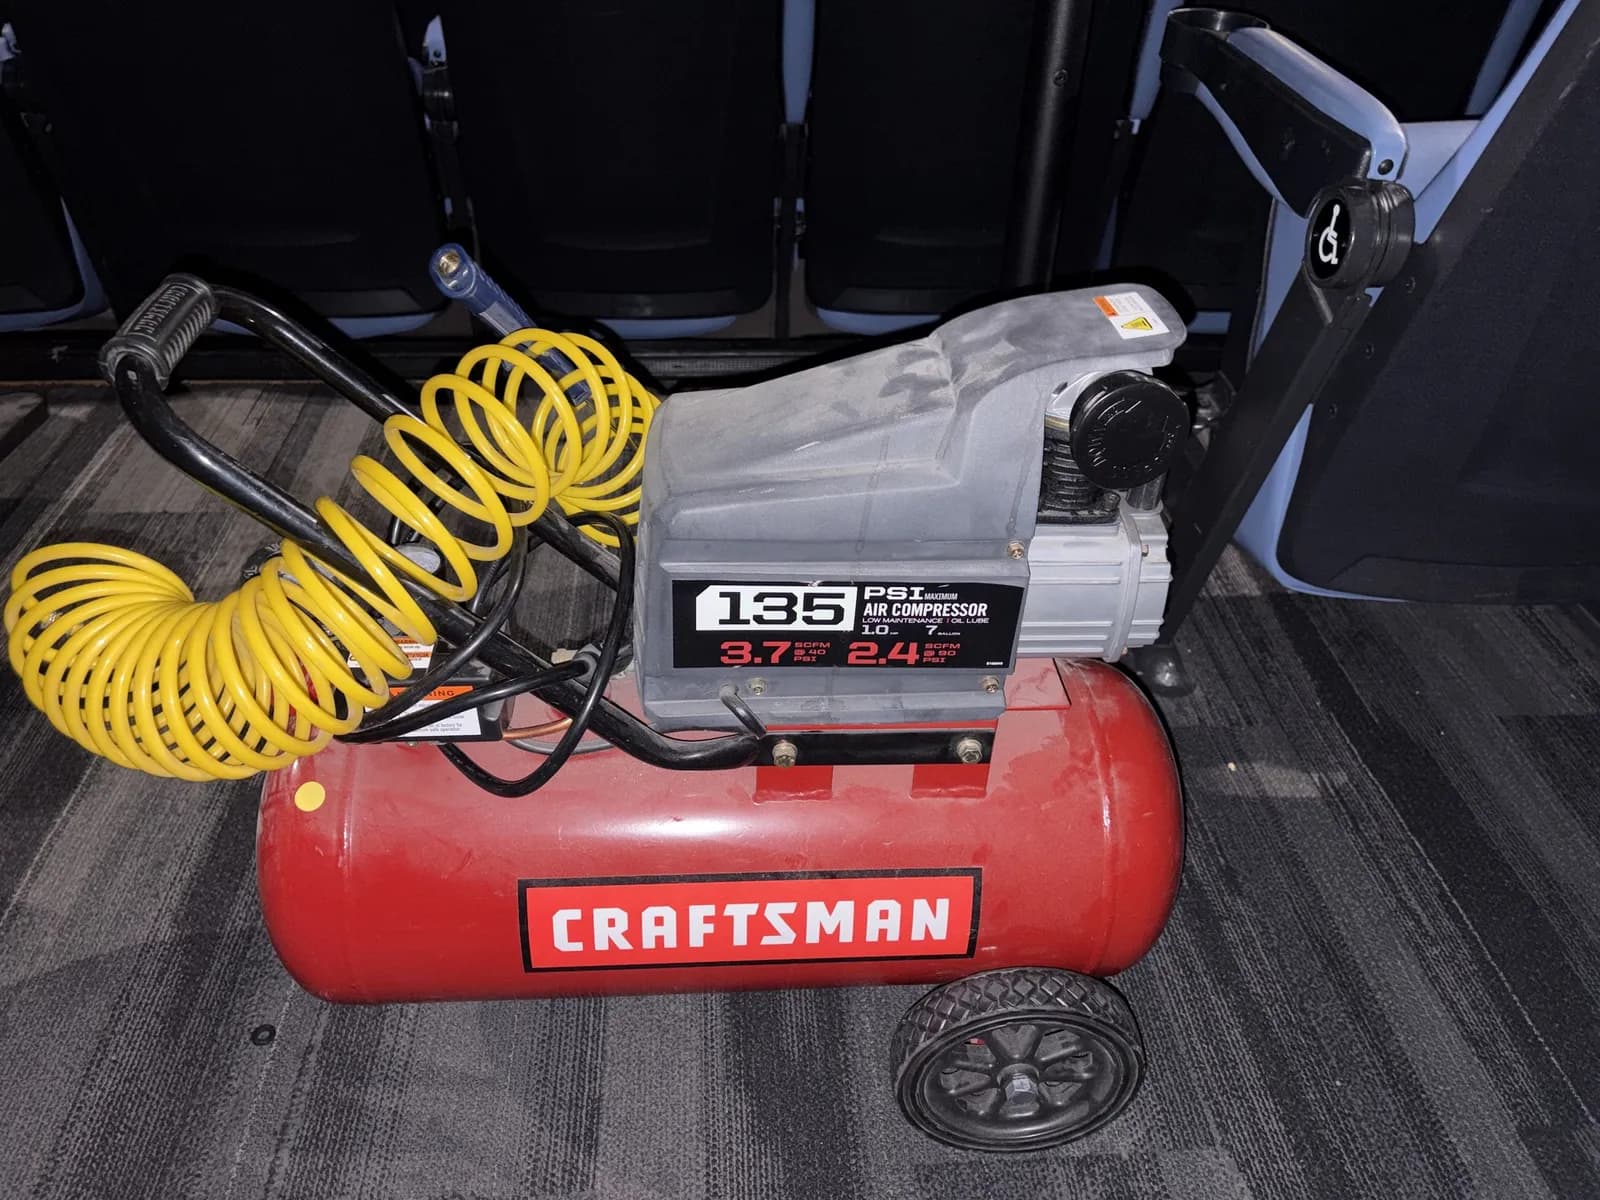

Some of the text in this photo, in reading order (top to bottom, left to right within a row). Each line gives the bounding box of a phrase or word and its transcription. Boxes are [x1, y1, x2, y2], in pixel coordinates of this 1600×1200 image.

[864, 586, 925, 600] PSI
[719, 592, 845, 625] 135
[863, 603, 988, 617] AIR COMPRESSOR
[861, 625, 890, 635] 1.0
[925, 625, 938, 636] 7
[720, 641, 792, 664] 3.7
[848, 641, 920, 665] 2.4
[552, 898, 949, 952] CRAFTSMAN
